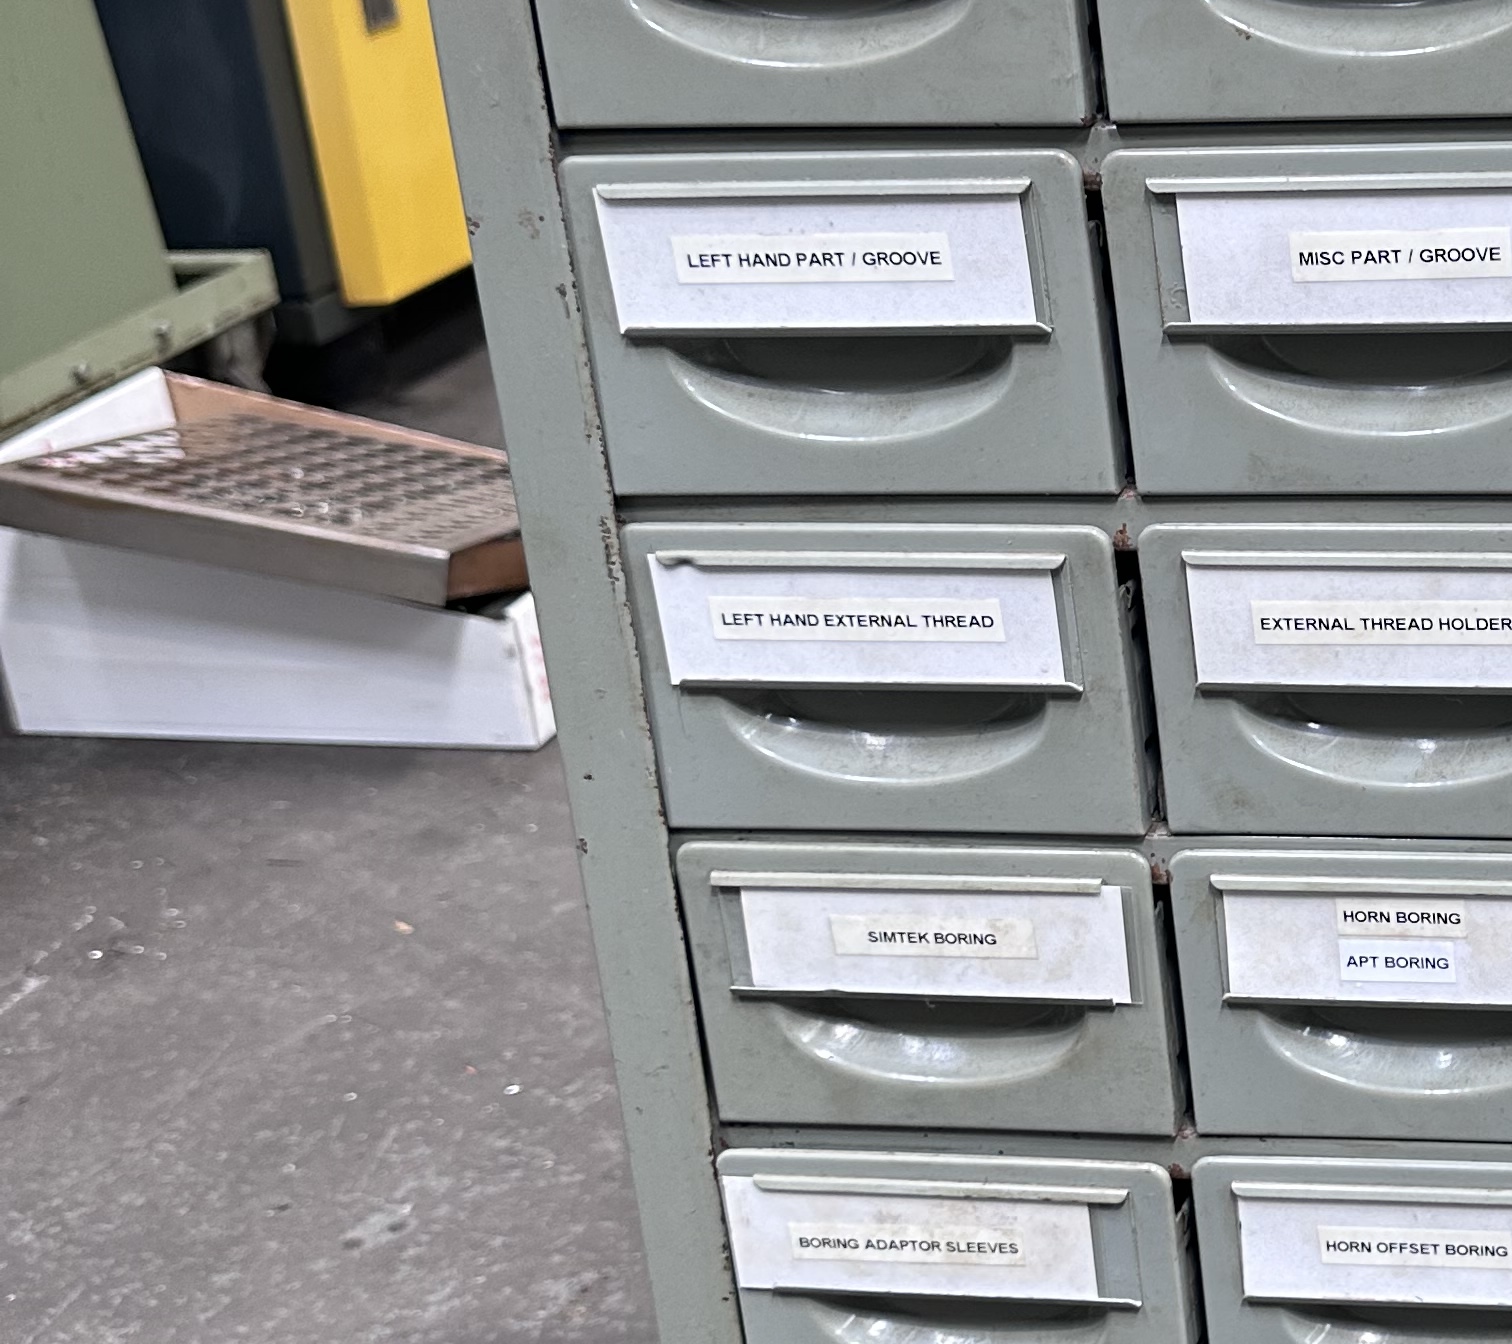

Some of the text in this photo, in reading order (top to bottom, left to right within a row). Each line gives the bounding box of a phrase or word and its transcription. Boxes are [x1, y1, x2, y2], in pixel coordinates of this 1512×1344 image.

[686, 253, 733, 268] LEFT
[737, 252, 792, 268] HAND
[796, 252, 845, 267] PART
[861, 250, 943, 266] GROOVE
[1298, 246, 1502, 266] MISC PART / GROOVE
[721, 612, 995, 629] LEFT HAND EXTERNAL THREAD
[1259, 617, 1355, 631] EXTERNAL
[1359, 617, 1434, 631] THREAD
[1343, 910, 1462, 925] HORN BORING
[867, 931, 997, 946] SIMTEK BORING
[1346, 955, 1450, 970] APT BORING
[799, 1236, 1019, 1255] BORING ADAPTOR SLEEVES
[1325, 1240, 1508, 1258] HORN OFFSET BORING
